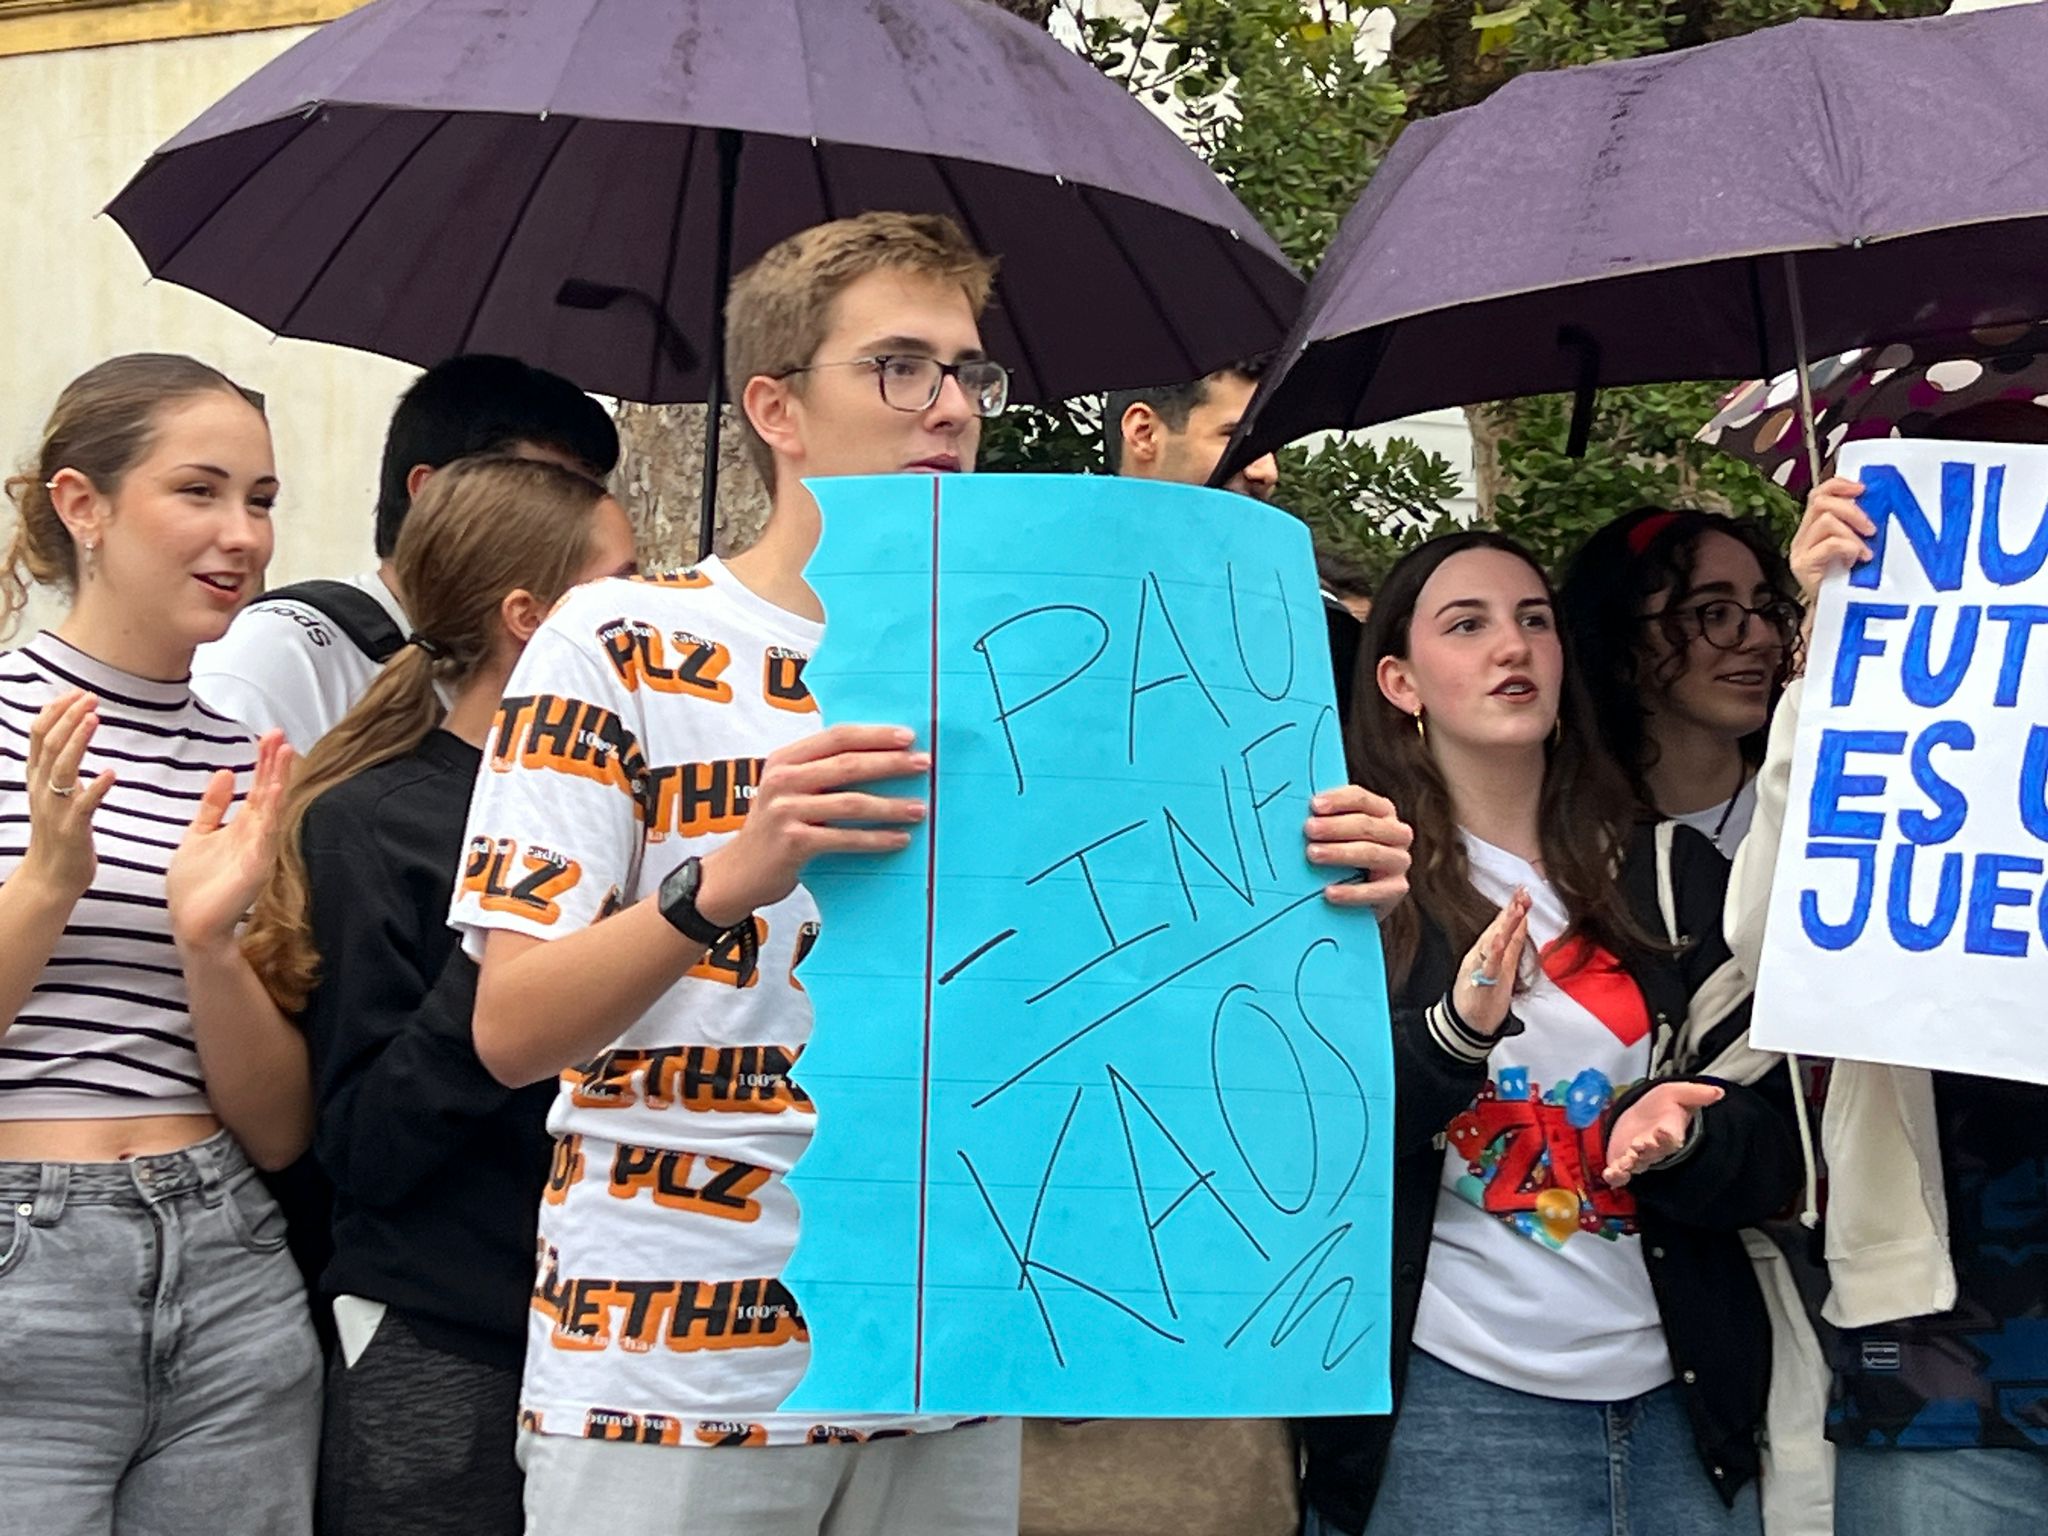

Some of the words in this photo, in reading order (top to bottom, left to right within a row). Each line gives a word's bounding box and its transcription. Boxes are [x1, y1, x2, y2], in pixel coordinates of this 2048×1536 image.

[596, 616, 733, 704] PLZ
[973, 561, 1296, 796] PAU
[1831, 602, 2048, 708] FUT
[1807, 720, 1975, 846] ES
[1800, 843, 2048, 958] JUE
[609, 1143, 773, 1221] PLZ
[957, 938, 1369, 1368] KAOS
